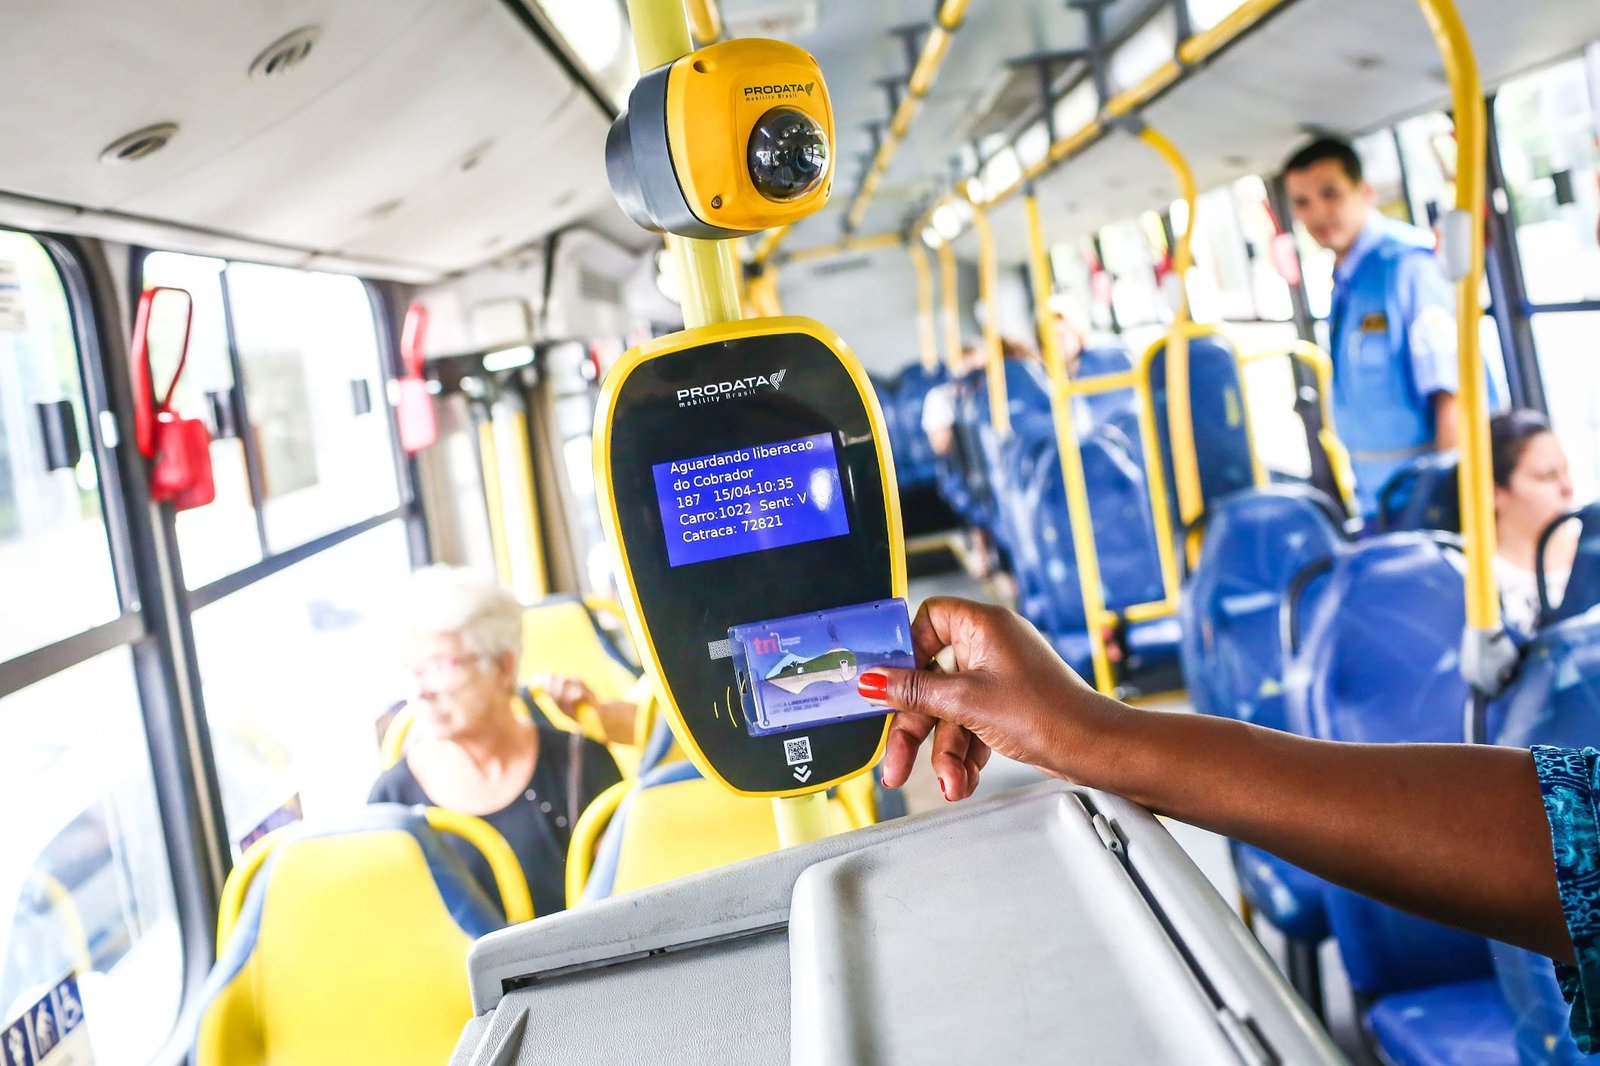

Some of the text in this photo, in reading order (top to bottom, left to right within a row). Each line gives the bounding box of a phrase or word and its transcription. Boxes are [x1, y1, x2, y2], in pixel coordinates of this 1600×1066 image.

[744, 84, 805, 96] PRODATA
[676, 375, 770, 401] PRODATA
[679, 388, 756, 408] mobility Brasil
[670, 439, 814, 475] Aguardando liberacao
[673, 467, 754, 491] do Cobrador
[676, 477, 794, 509] 187 15/04-10:35
[679, 492, 807, 525] Carro:1022 Sent: V
[682, 514, 783, 543] Catraca: 72821
[753, 636, 778, 656] tri
